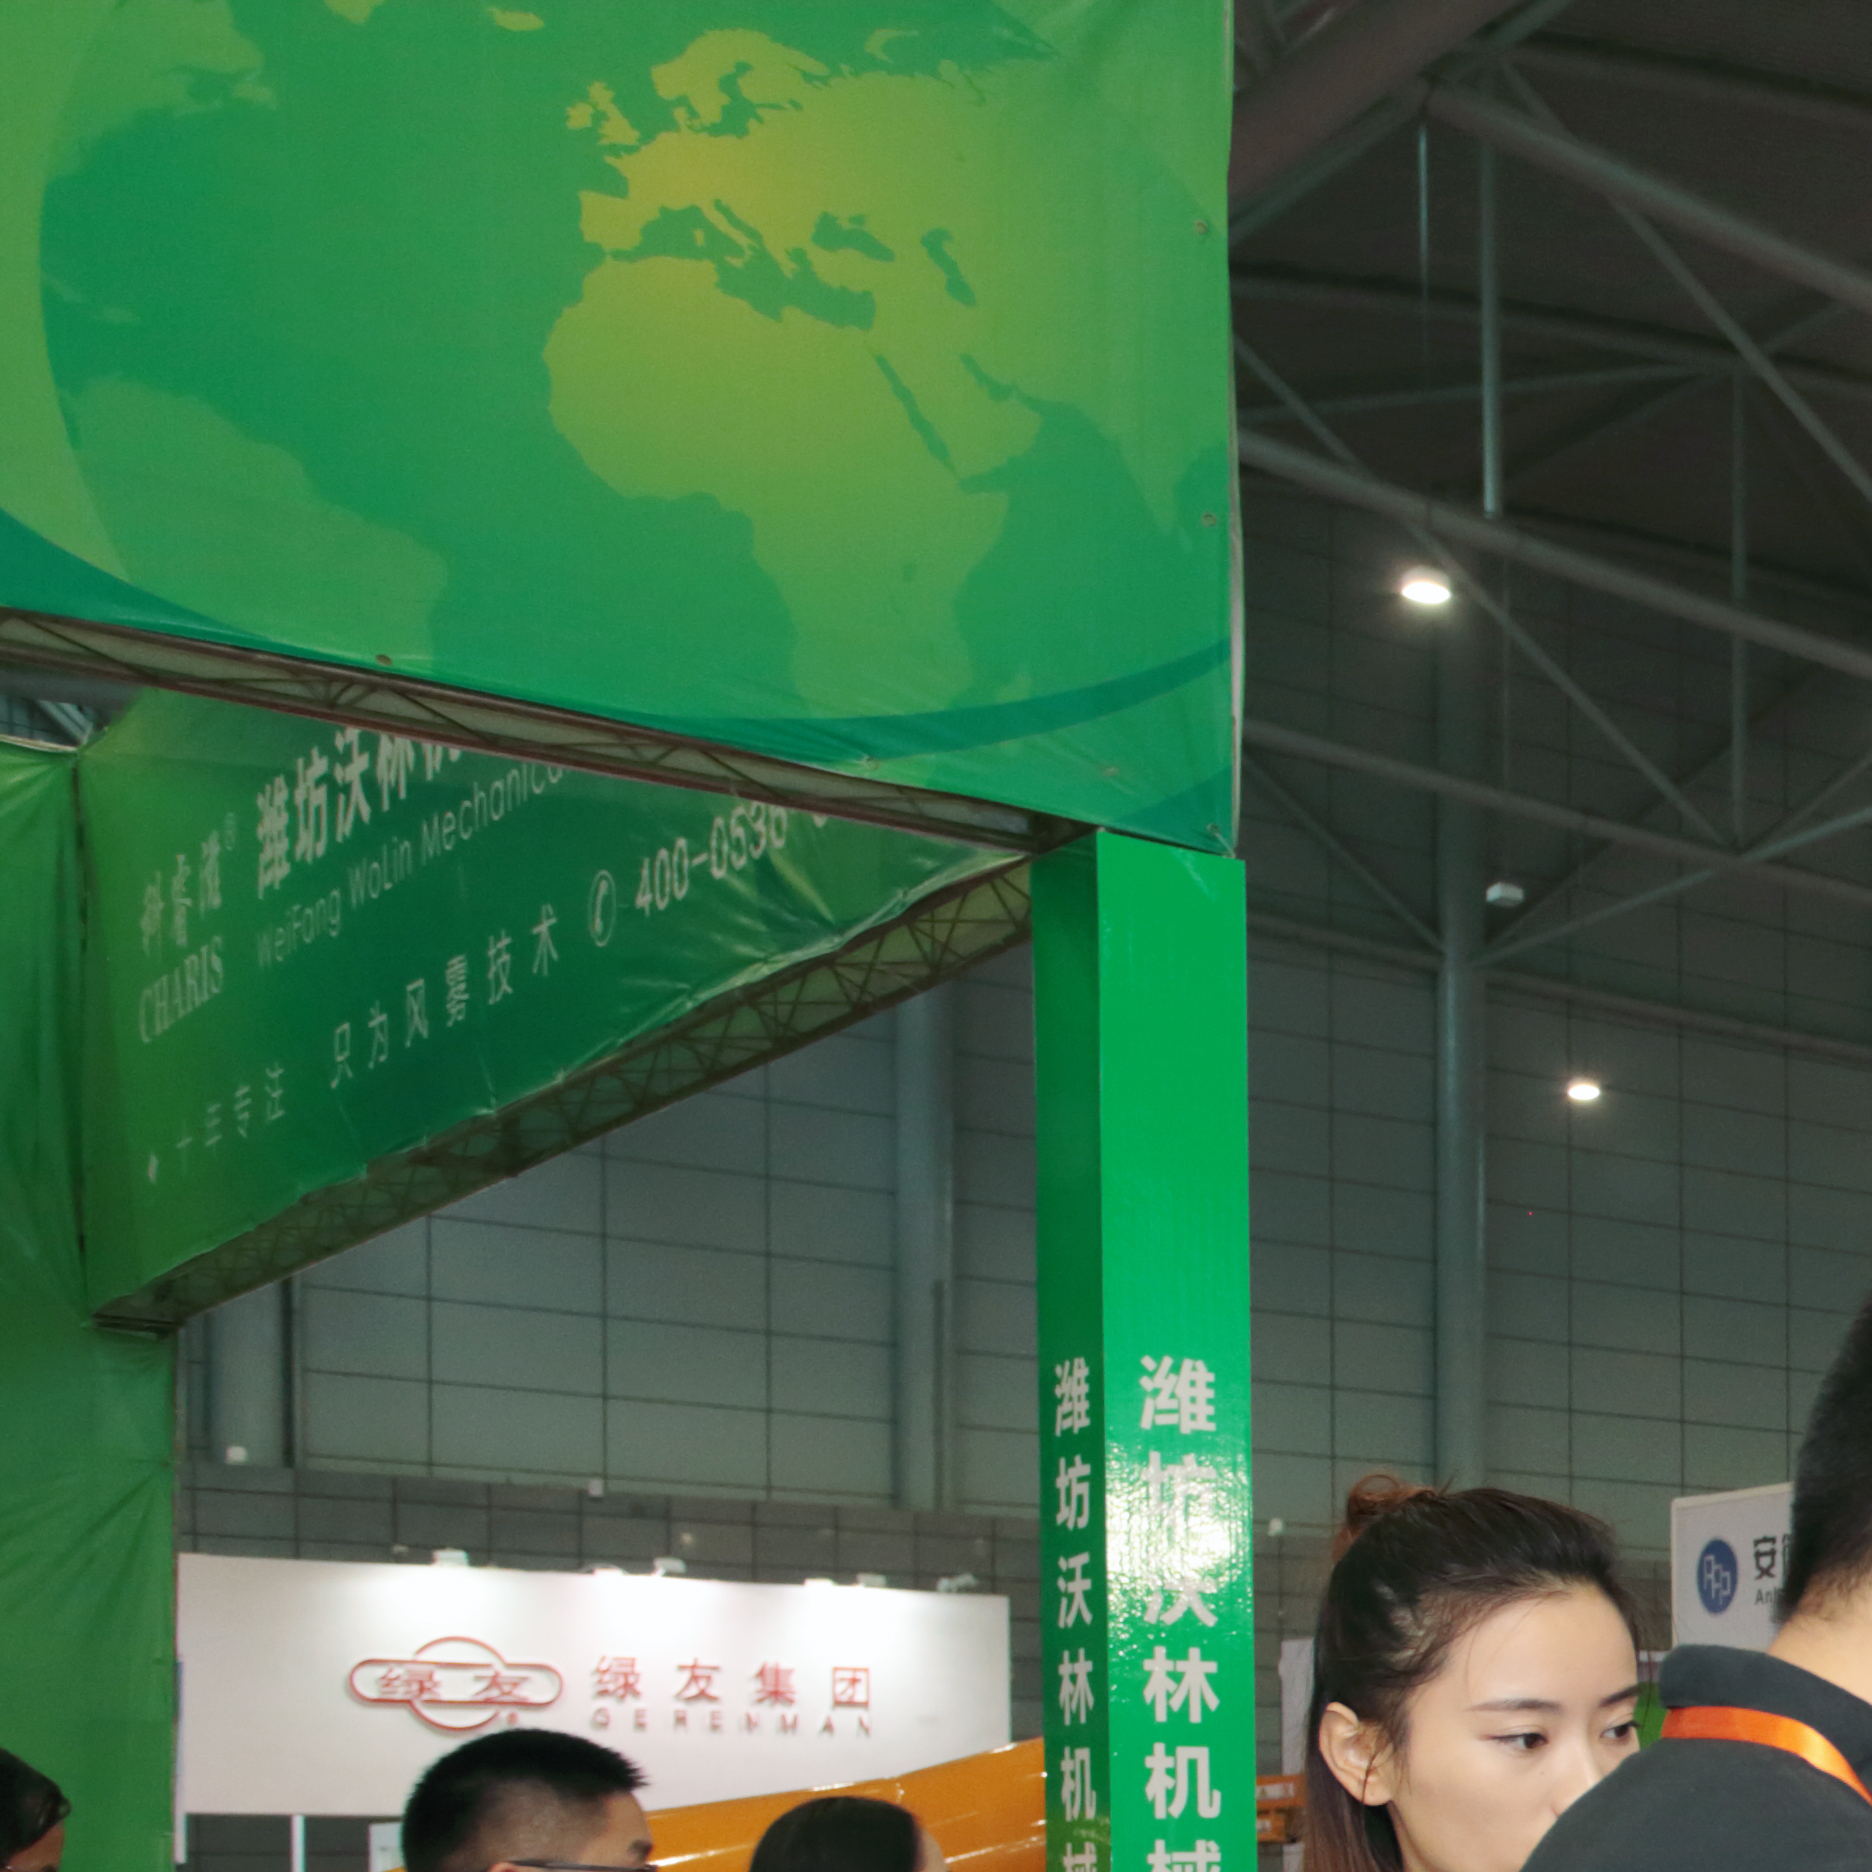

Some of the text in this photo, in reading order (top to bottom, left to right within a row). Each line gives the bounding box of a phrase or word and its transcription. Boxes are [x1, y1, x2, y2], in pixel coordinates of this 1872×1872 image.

[138, 935, 223, 1043] CHARIS
[377, 1664, 530, 1701] 绿友
[594, 1655, 870, 1706] 绿友集团
